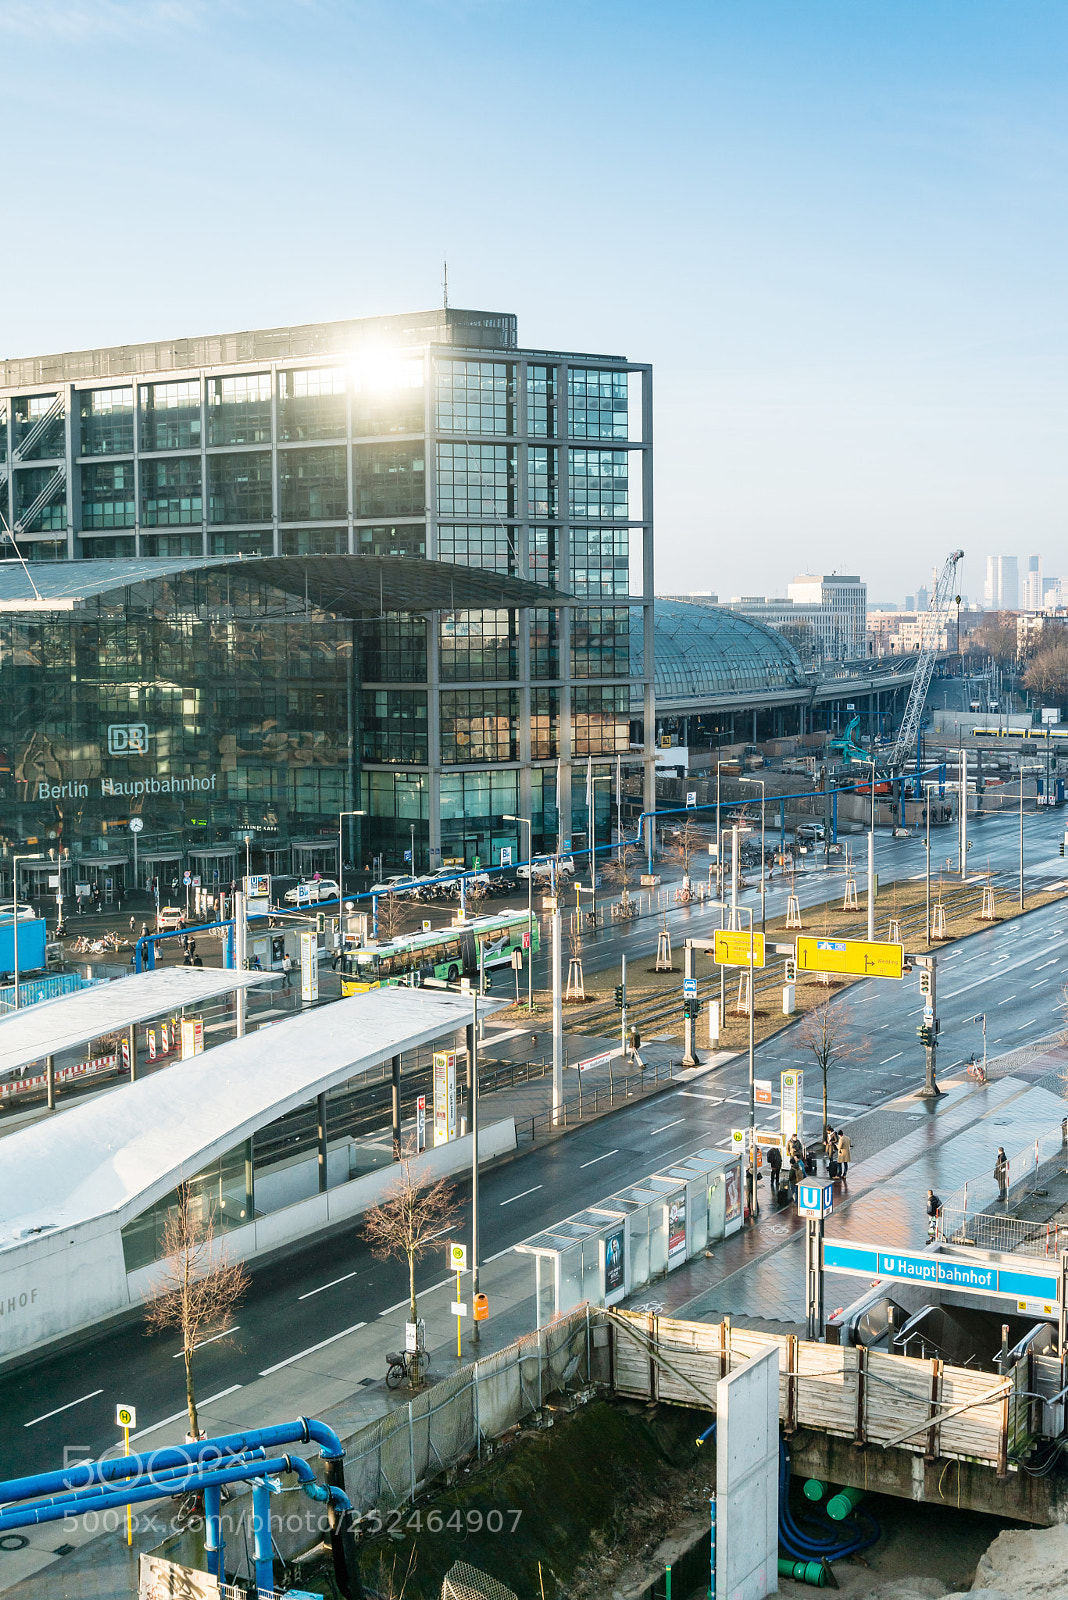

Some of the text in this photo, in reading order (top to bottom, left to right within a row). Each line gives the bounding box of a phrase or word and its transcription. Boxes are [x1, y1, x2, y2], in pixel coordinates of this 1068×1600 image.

[113, 728, 143, 750] DB
[38, 774, 217, 800] Berlin Hauptbahnhof
[803, 1188, 818, 1208] U
[825, 1186, 831, 1206] U
[884, 1257, 992, 1286] U Hauptbahnhof
